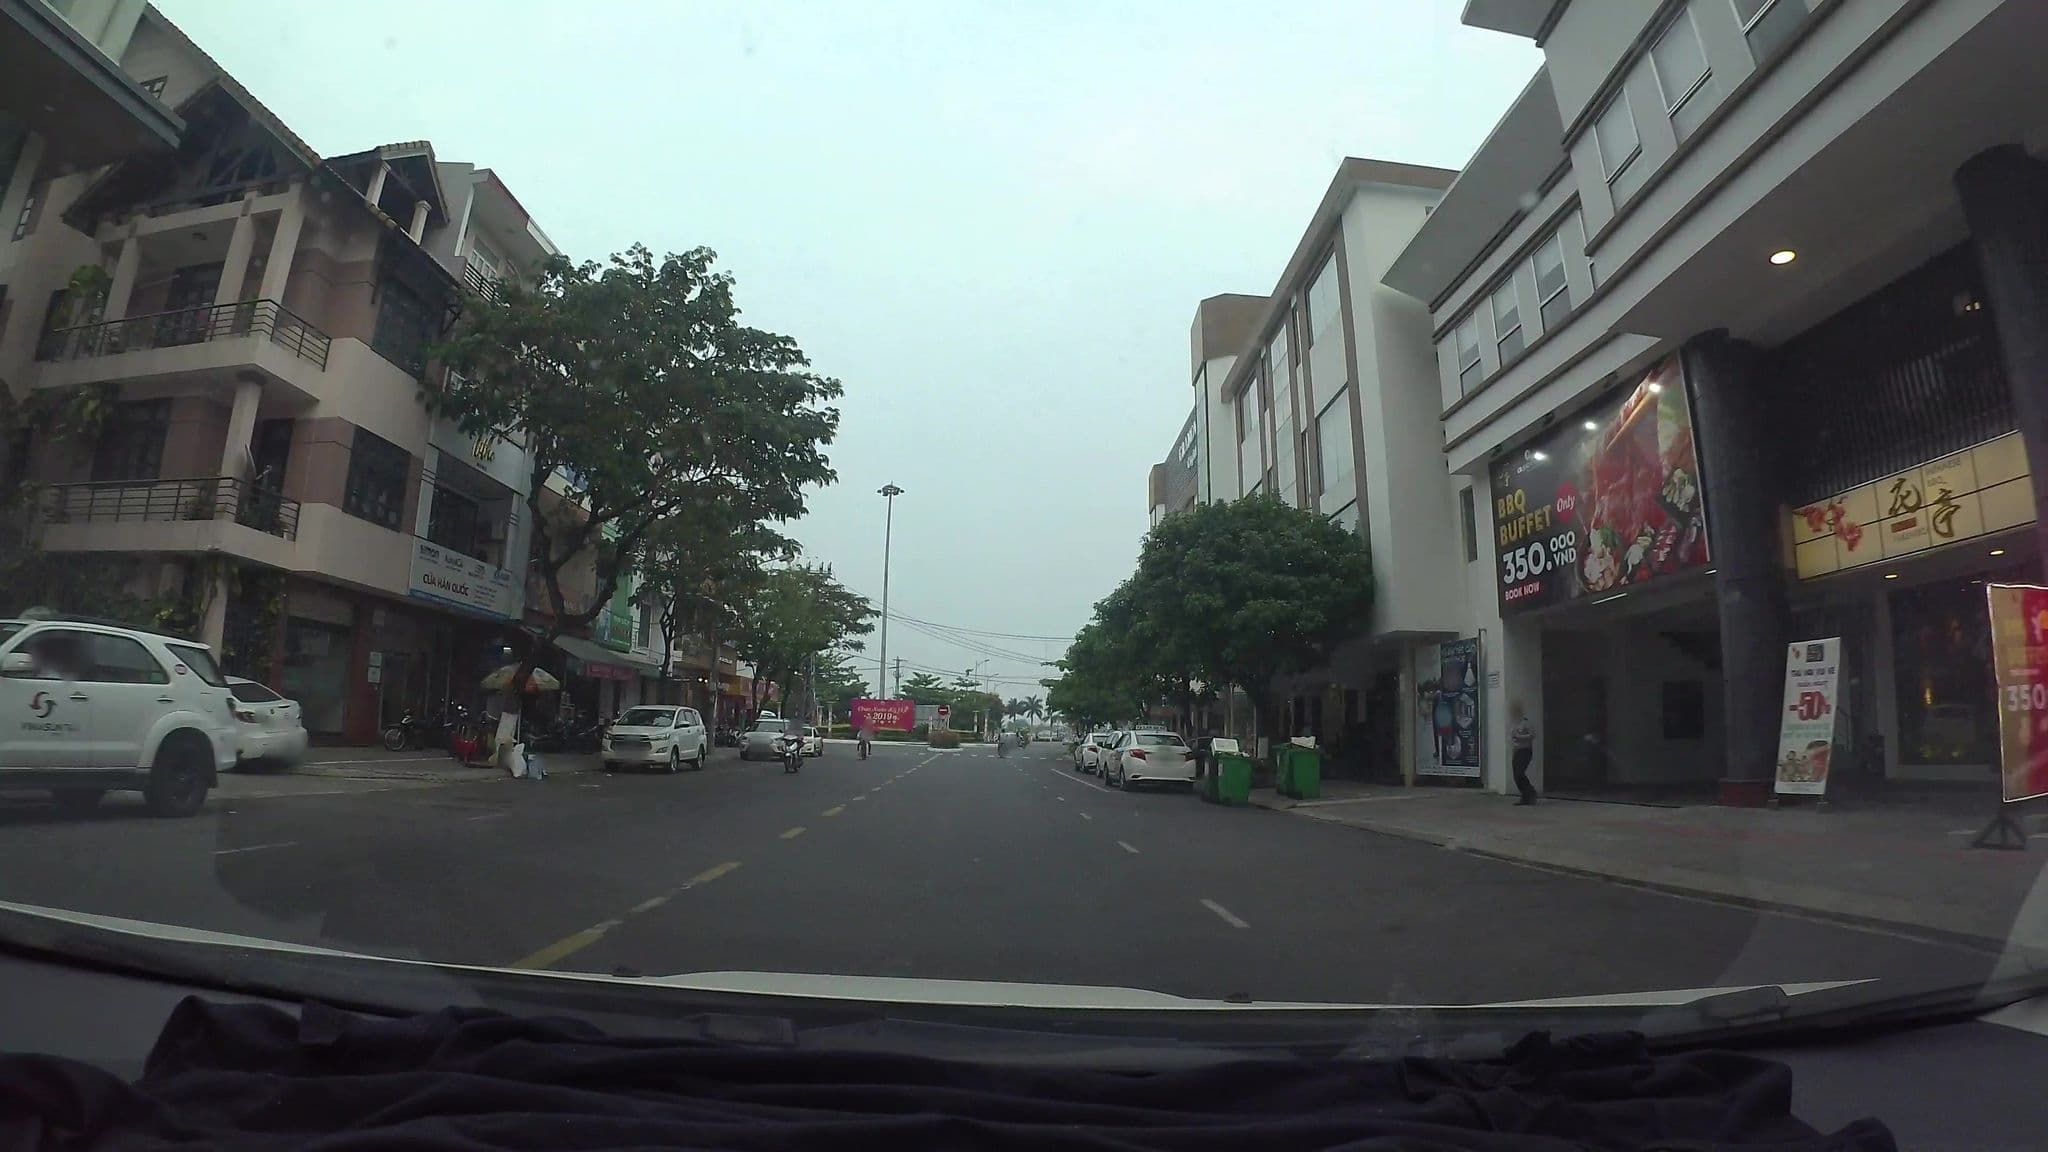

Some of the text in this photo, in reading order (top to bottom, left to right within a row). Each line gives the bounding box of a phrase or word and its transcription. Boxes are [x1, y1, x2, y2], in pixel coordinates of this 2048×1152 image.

[1498, 489, 1526, 519] BBQ
[1557, 495, 1576, 513] Only
[1499, 504, 1552, 546] BUFFET
[1550, 531, 1576, 552] 000
[1553, 547, 1577, 567] VND
[1505, 582, 1540, 601] BOOK NOW
[872, 712, 892, 721] 2019
